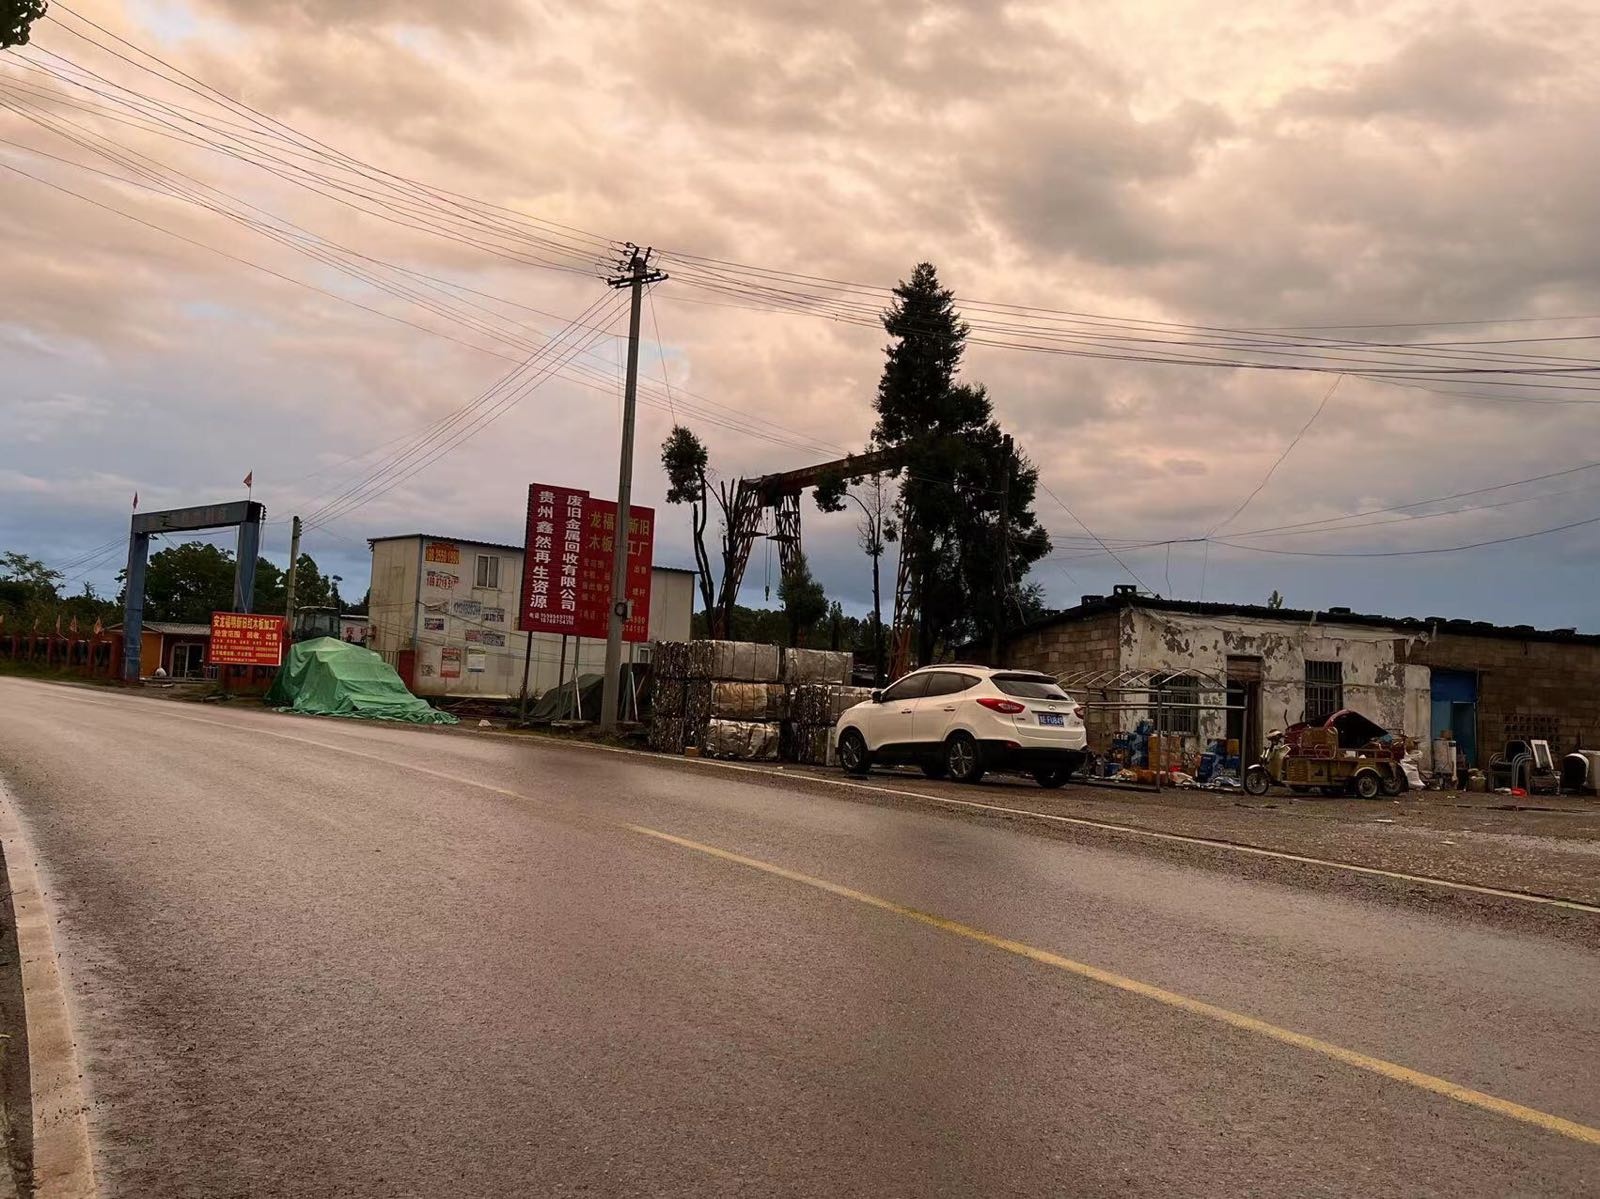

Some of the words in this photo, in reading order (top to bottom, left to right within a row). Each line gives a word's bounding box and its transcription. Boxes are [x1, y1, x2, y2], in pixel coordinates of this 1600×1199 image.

[530, 491, 556, 609] 贵州鑫然再生资源
[560, 495, 583, 611] 废旧金属回收有限公司
